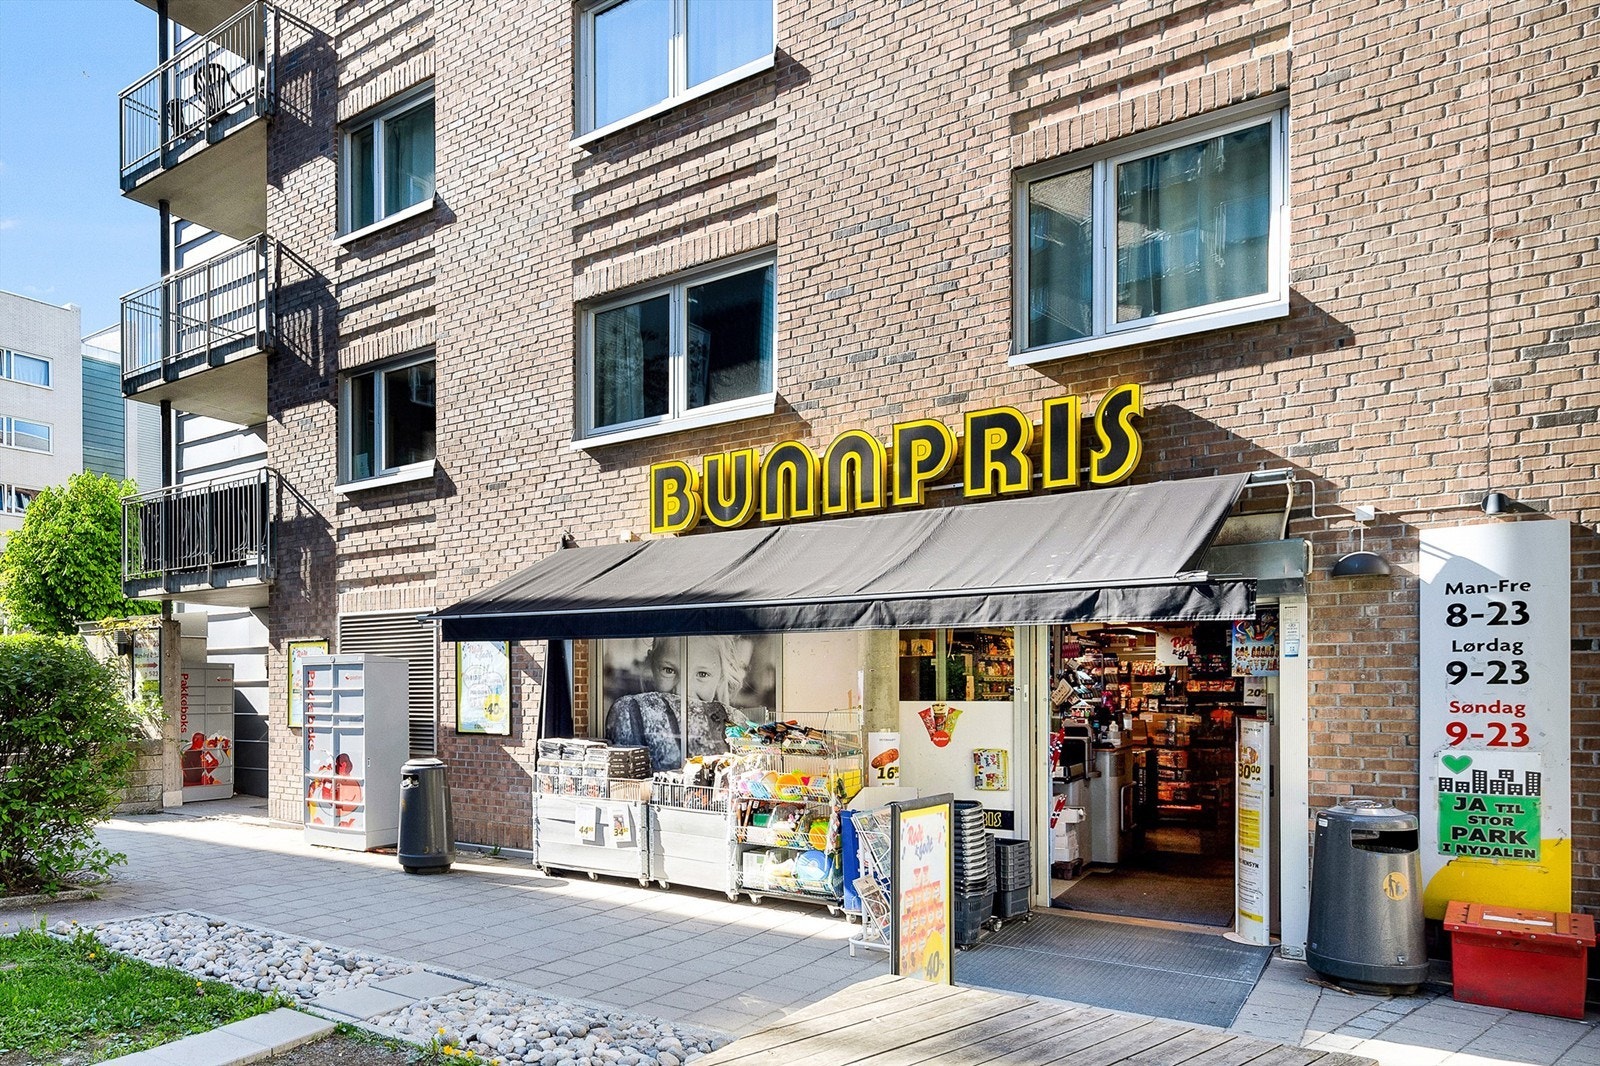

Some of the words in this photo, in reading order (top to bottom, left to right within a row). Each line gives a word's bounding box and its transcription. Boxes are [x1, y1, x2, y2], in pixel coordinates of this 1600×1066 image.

[649, 383, 1145, 535] BUNNPRIS
[1444, 580, 1531, 595] Man-Fre
[1445, 600, 1530, 627] 8-23
[1452, 638, 1524, 655] Lørdag
[1445, 660, 1530, 685] 9-23
[181, 674, 189, 733] Pakkeboks
[1450, 700, 1526, 718] Søndag
[1445, 721, 1530, 747] 9-23
[1453, 797, 1487, 812] JA
[1495, 804, 1525, 814] TIL
[1468, 815, 1514, 827] STOR
[1452, 826, 1528, 845] PARK
[1443, 843, 1451, 852] I
[1456, 844, 1536, 859] NYDALEN
